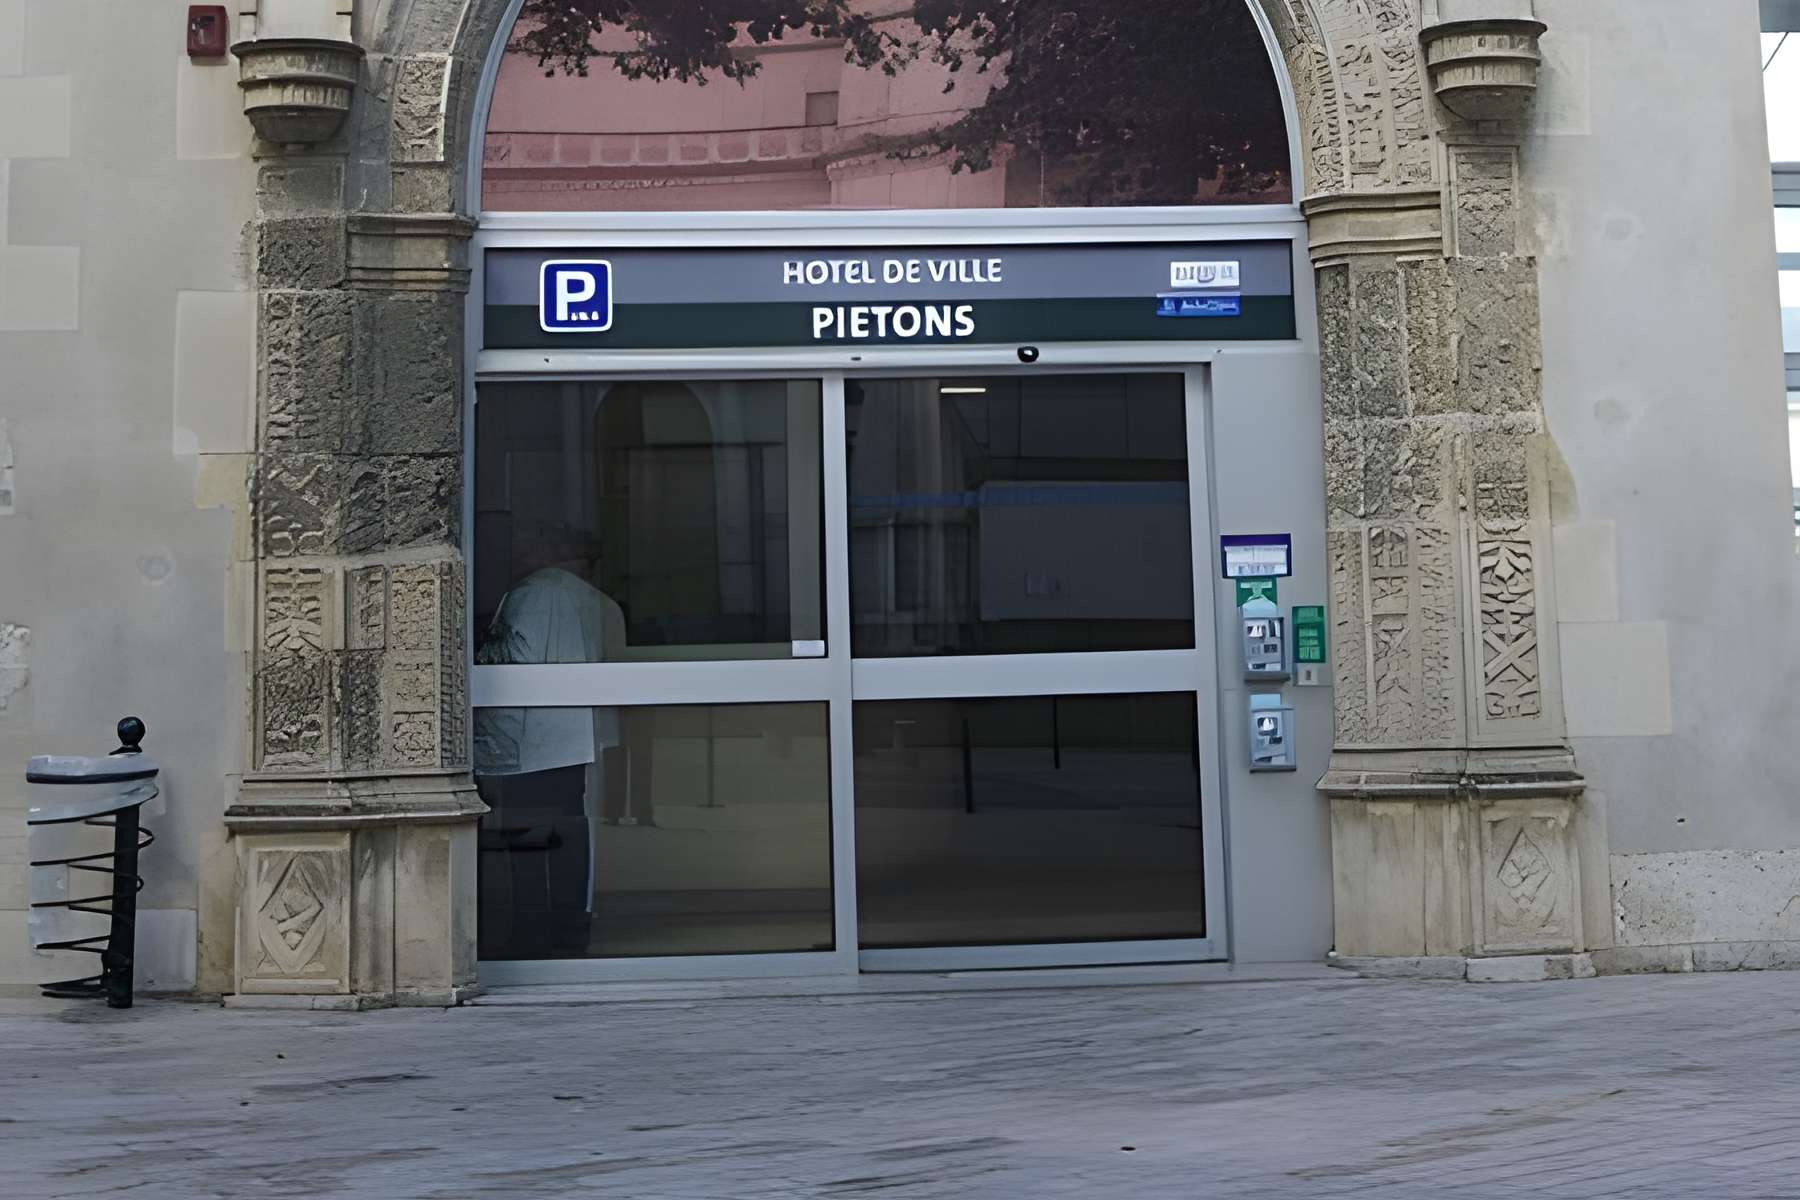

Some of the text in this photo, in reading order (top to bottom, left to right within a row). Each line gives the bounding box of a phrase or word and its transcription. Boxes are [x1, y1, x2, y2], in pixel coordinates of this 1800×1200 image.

[783, 258, 1002, 285] HOTEL DE VILLE
[556, 270, 596, 321] P
[812, 305, 975, 338] PIETONS
